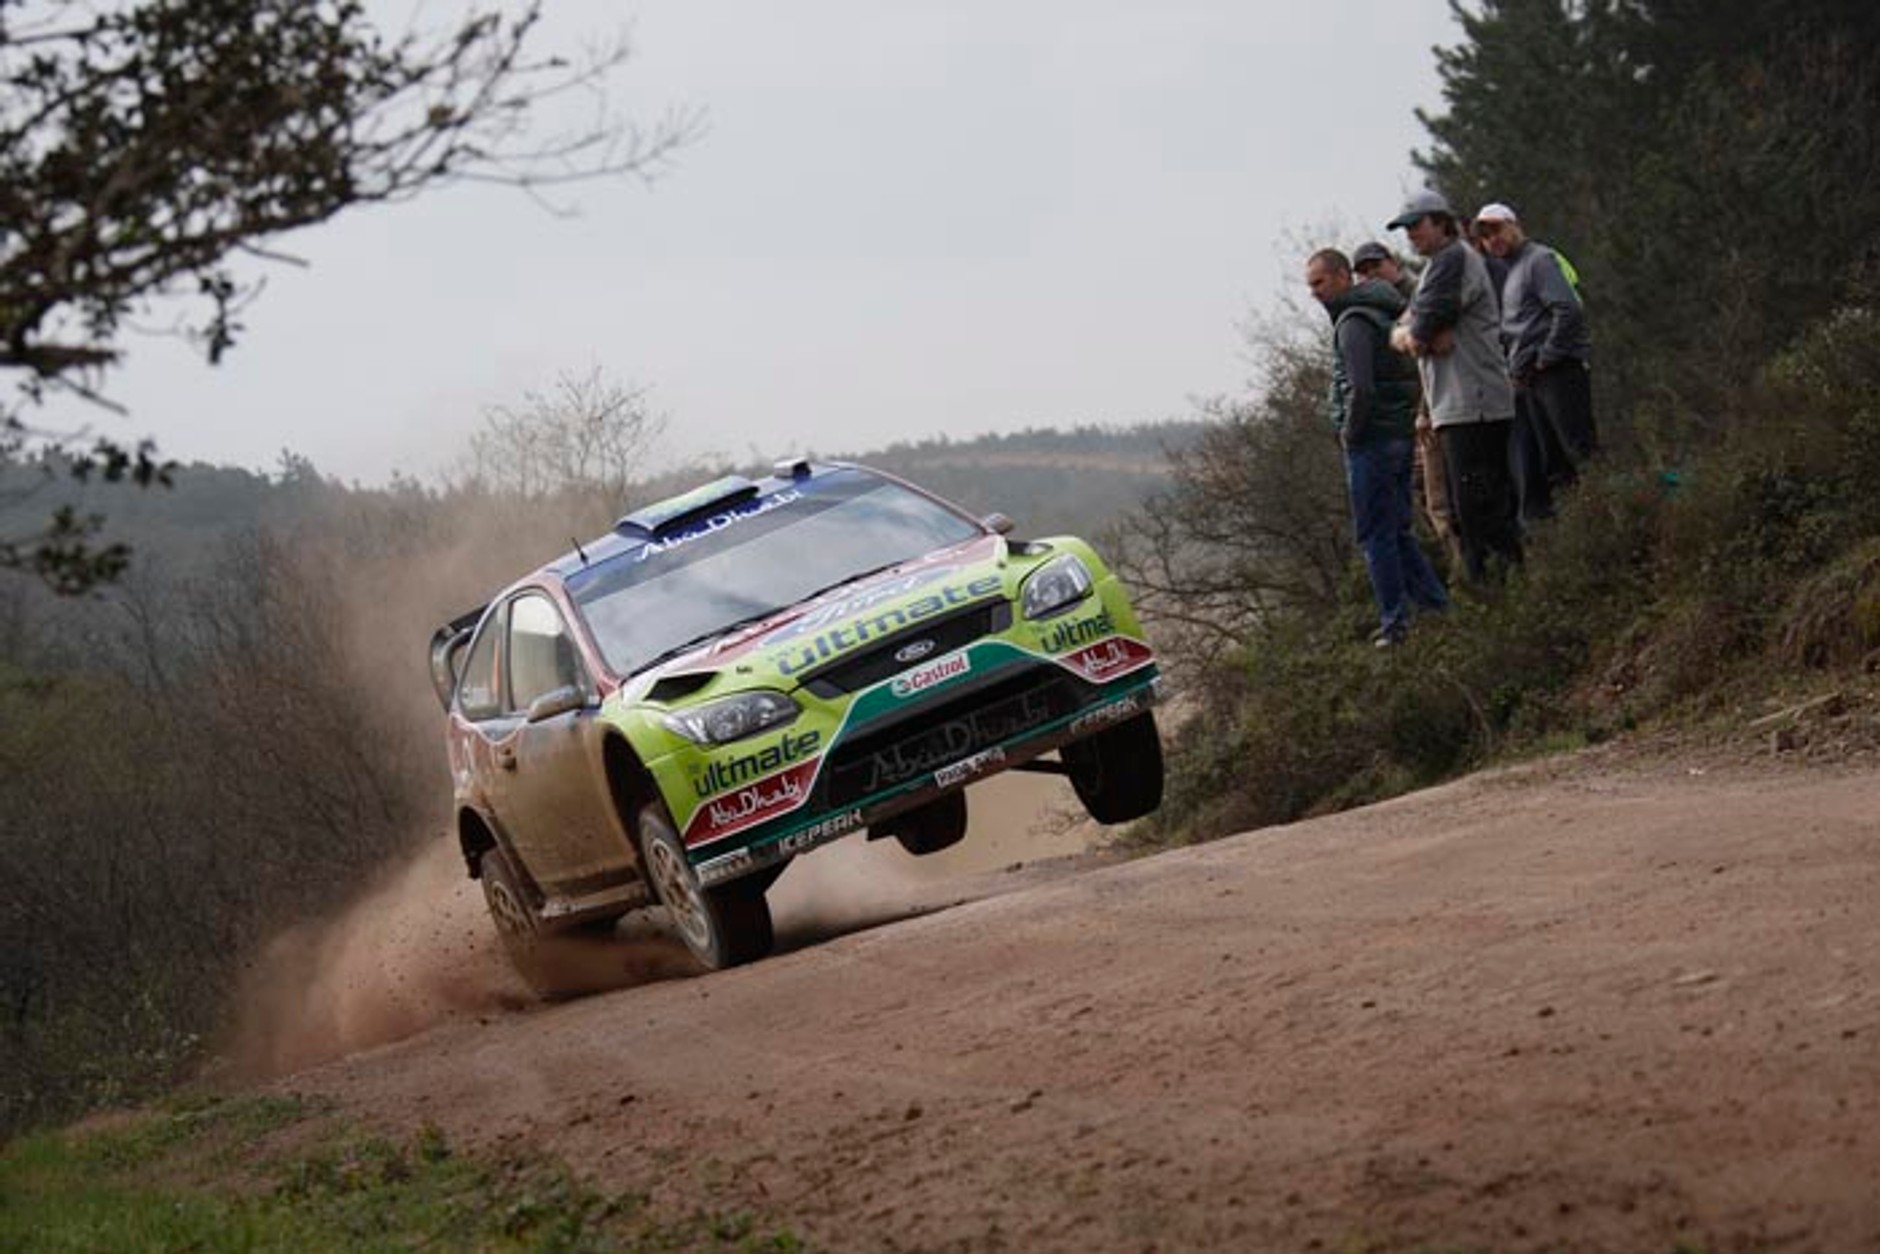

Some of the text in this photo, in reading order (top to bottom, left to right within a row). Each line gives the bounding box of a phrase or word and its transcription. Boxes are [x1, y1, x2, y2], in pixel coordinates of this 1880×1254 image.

[777, 574, 1002, 676] ultimate
[912, 655, 966, 689] Castrol
[692, 729, 821, 797] ultimate
[778, 808, 863, 854] ICEPEAK
